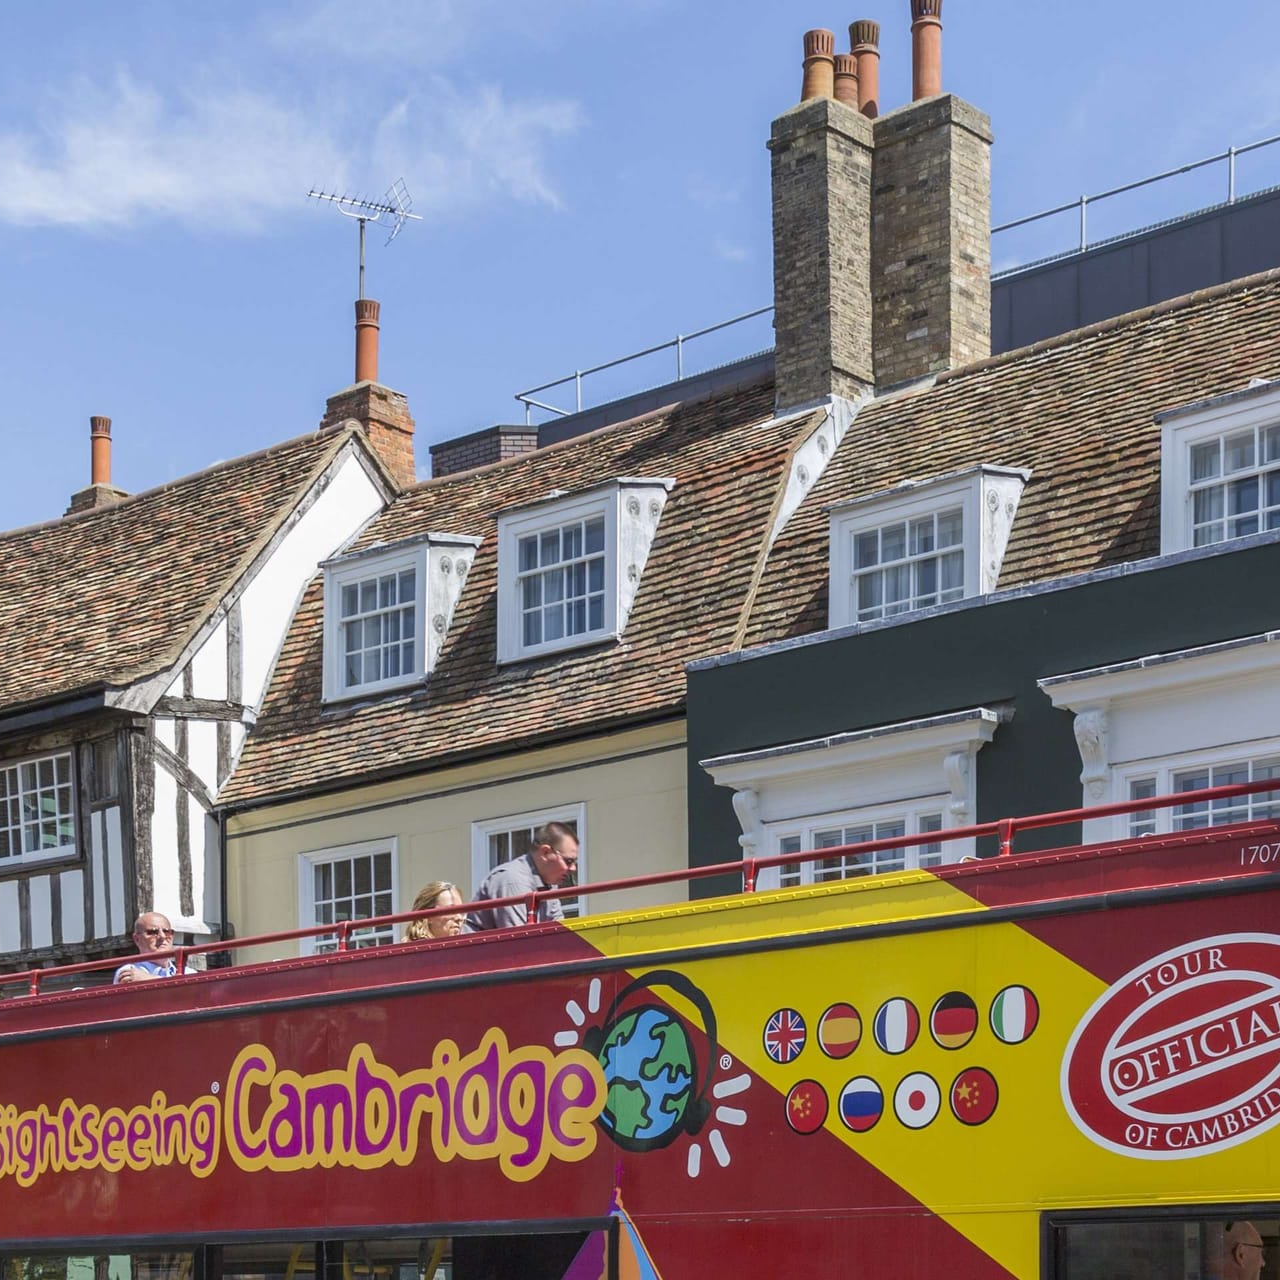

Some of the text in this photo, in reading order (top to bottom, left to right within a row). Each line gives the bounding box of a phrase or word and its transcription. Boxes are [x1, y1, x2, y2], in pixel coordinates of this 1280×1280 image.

[1135, 948, 1228, 997] TOUR
[228, 1032, 604, 1177] Cambridge
[1125, 1122, 1160, 1148] OF
